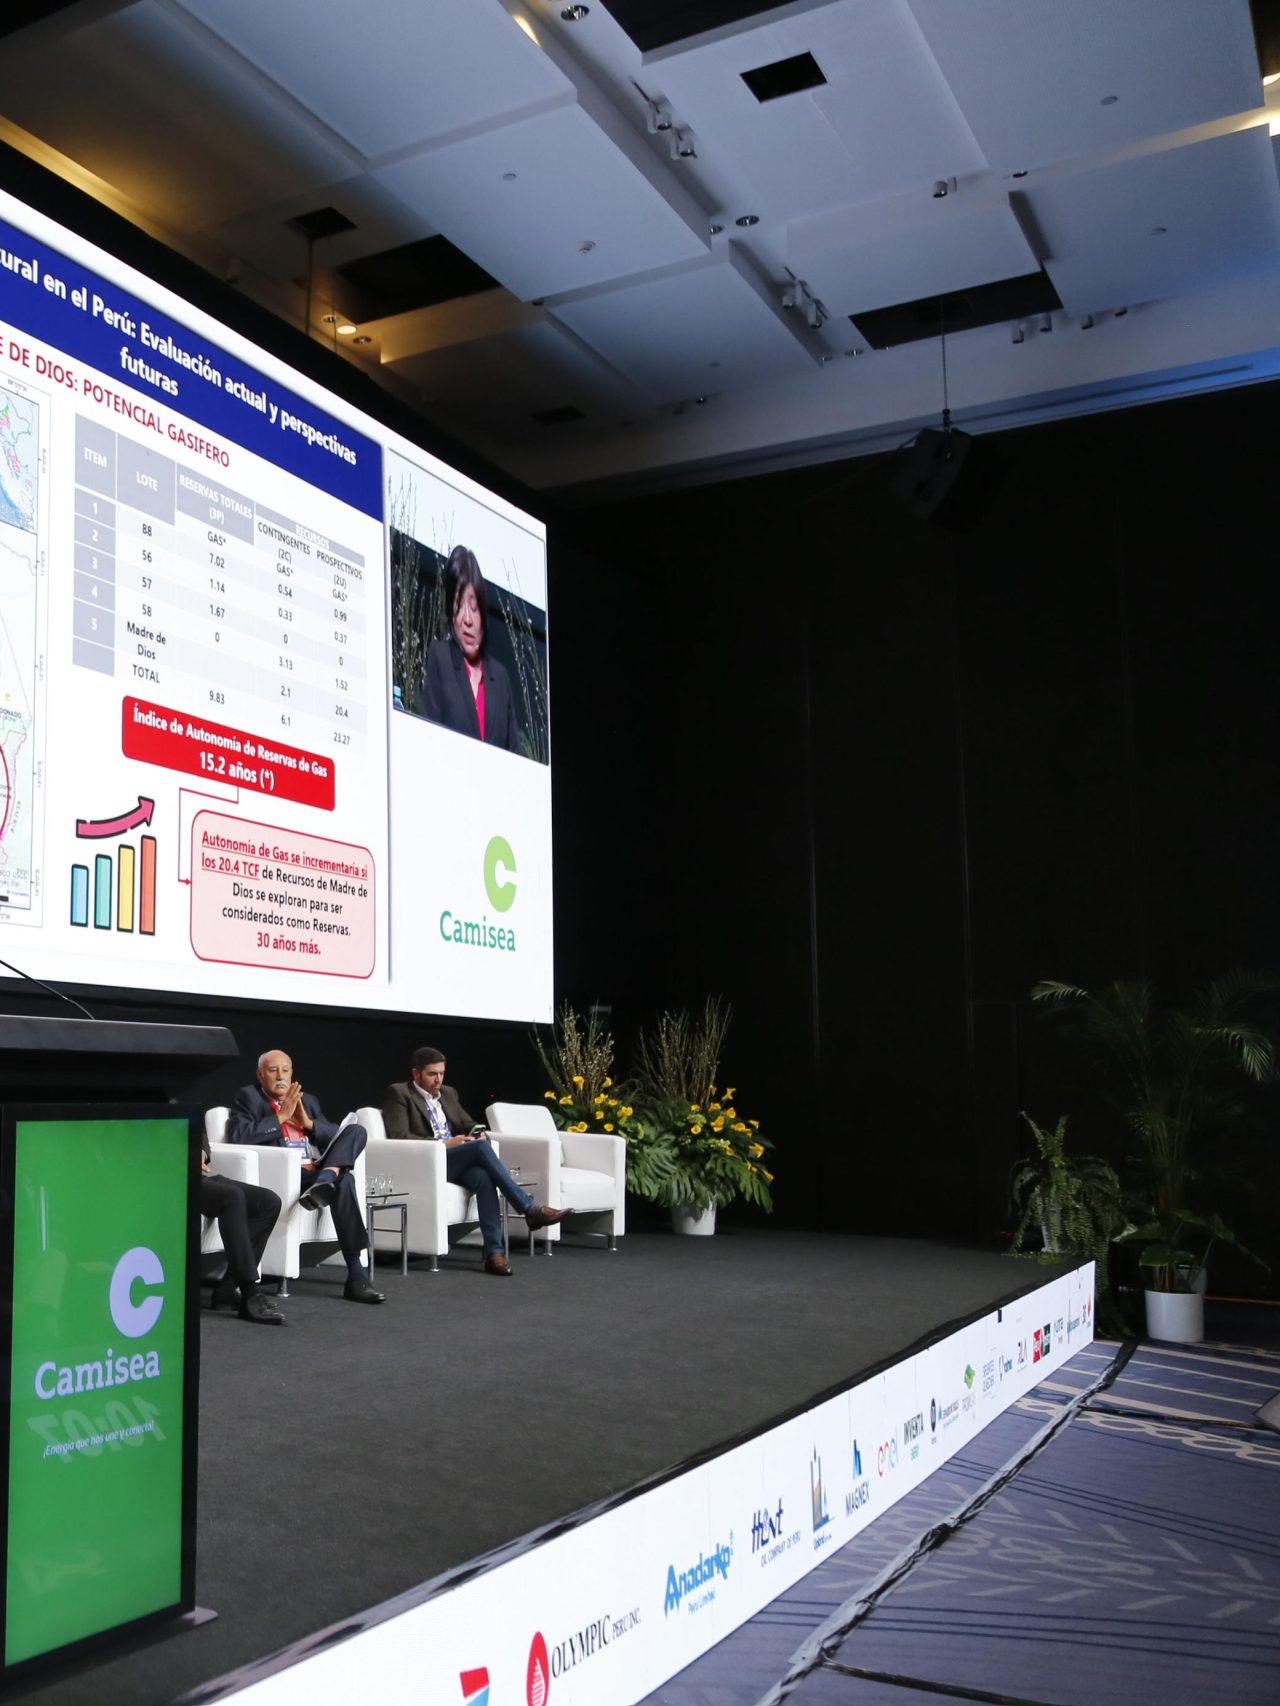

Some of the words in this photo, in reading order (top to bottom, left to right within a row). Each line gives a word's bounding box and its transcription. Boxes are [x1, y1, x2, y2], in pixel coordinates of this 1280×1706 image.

[43, 274, 67, 300] en
[71, 287, 88, 311] el
[92, 293, 137, 339] Perú:
[140, 321, 222, 388] Evaluación
[224, 375, 267, 415] actual
[268, 403, 279, 424] y
[281, 409, 358, 466] perspectivas
[120, 346, 179, 397] futuras
[9, 341, 31, 368] DE
[35, 354, 79, 392] DIOS:
[83, 378, 164, 435] POTENCIAL
[167, 424, 231, 468] GASIFERO
[84, 447, 108, 468] ITEM
[136, 471, 159, 492] LOTE
[179, 474, 219, 504] RESERVAS
[220, 494, 252, 519] TOTALES
[93, 502, 98, 514] 1
[209, 506, 225, 525] (3P)
[91, 528, 99, 542] 2
[142, 523, 153, 537] 88
[258, 521, 311, 555] CONTINGENTES
[90, 556, 98, 569] 3
[142, 549, 153, 563] 56
[209, 553, 225, 569] 7.02
[278, 548, 293, 565] (2C)
[316, 549, 363, 580] PROSPECTIVOS
[142, 576, 152, 590] 57
[209, 578, 225, 593] 1.14
[333, 574, 347, 590] (2U)
[91, 585, 99, 598] 4
[278, 583, 293, 598] 0.54
[142, 603, 152, 617] 58
[209, 604, 225, 619] 1.67
[278, 607, 293, 622] 0.33
[333, 608, 348, 622] 0.99
[90, 618, 98, 631] 5
[126, 621, 154, 640] Madre
[155, 632, 167, 646] de
[214, 632, 220, 643] 0
[283, 633, 289, 644] 0
[334, 631, 348, 644] 0.37
[137, 643, 157, 660] Dios
[278, 656, 293, 670] 3.13
[338, 656, 344, 666] 0
[132, 664, 161, 684] TOTAL
[280, 685, 291, 698] 2.1
[335, 678, 348, 691] 1.52
[209, 690, 225, 705] 9.83
[335, 705, 349, 718] 20.4
[281, 714, 291, 727] 6.1
[133, 702, 168, 731] Índice
[170, 718, 184, 736] de
[186, 725, 242, 753] Autonomía
[243, 740, 256, 757] de
[257, 745, 298, 770] Reservas
[298, 757, 310, 772] de
[311, 761, 328, 778] Gas
[333, 731, 351, 746] 23.27
[200, 751, 226, 776] 15.2
[228, 761, 257, 784] años
[201, 830, 257, 855] Autonomía
[258, 842, 270, 858] de
[272, 846, 289, 862] Gas
[290, 852, 301, 865] se
[302, 851, 359, 877] incrementaría
[361, 864, 368, 878] si
[201, 852, 216, 869] los
[218, 856, 240, 874] 20.4
[242, 861, 261, 878] TCF
[262, 864, 274, 880] de
[276, 868, 315, 888] Recursos
[316, 875, 328, 890] de
[329, 879, 356, 896] Madre
[357, 884, 368, 899] de
[232, 882, 254, 900] Dios
[256, 888, 266, 901] se
[268, 891, 308, 910] exploran
[309, 898, 329, 914] para
[330, 902, 343, 915] ser
[222, 905, 284, 927] considerados
[286, 916, 311, 930] como
[312, 917, 351, 937] Reservas.
[439, 910, 516, 952] Camisea
[257, 931, 270, 948] 30
[272, 934, 297, 952] años
[298, 938, 321, 955] más.
[34, 1347, 160, 1401] Camisea
[75, 1436, 90, 1450] que
[90, 1432, 104, 1447] nos
[105, 1429, 119, 1442] une
[551, 1614, 612, 1680] OLYMPIC
[611, 1617, 628, 1641] PERU
